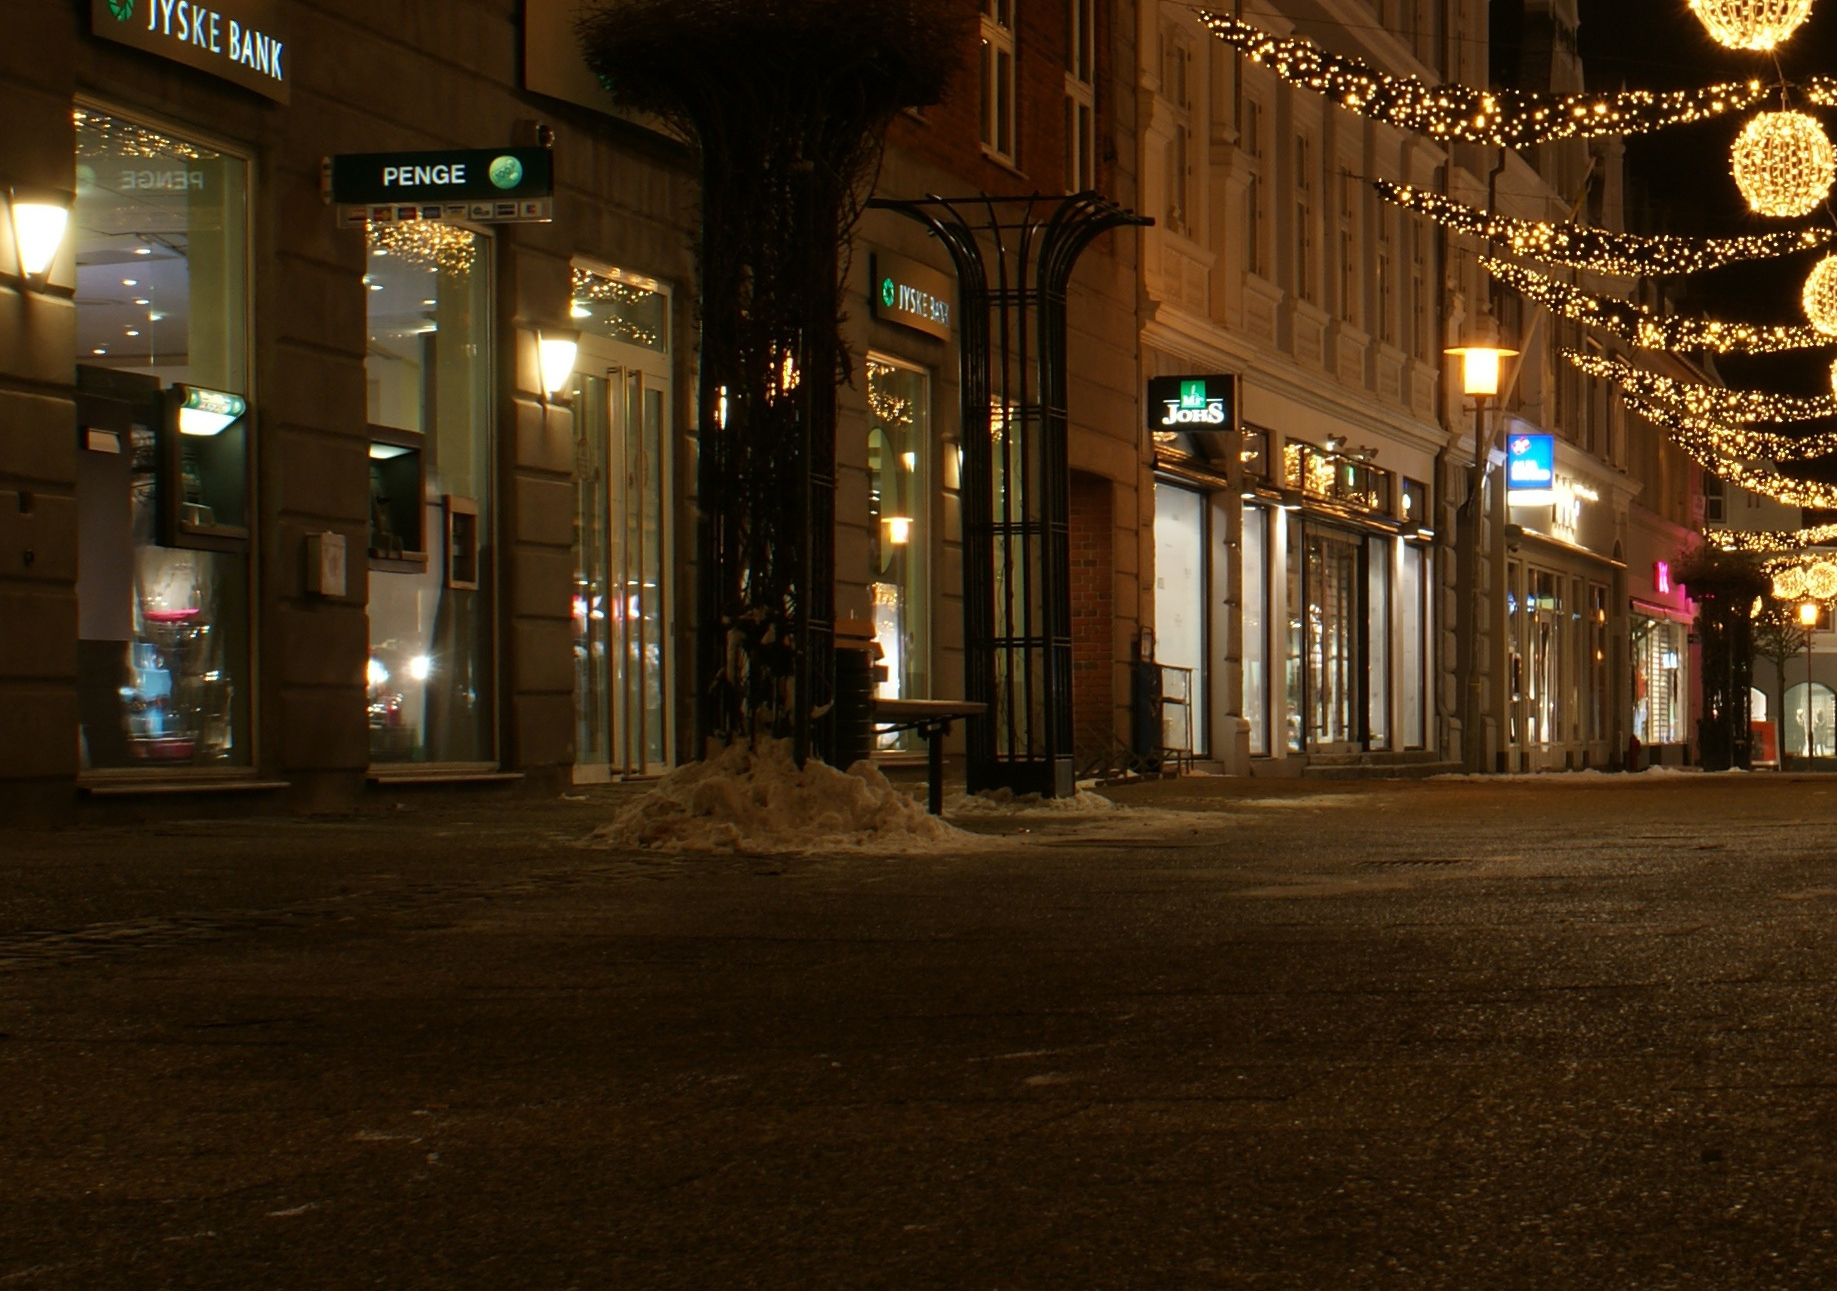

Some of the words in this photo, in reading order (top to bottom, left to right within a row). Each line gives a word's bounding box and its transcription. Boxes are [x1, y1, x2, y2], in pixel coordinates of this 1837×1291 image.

[229, 20, 283, 81] BANK
[383, 164, 466, 186] PENGE
[899, 284, 928, 317] JYSKE
